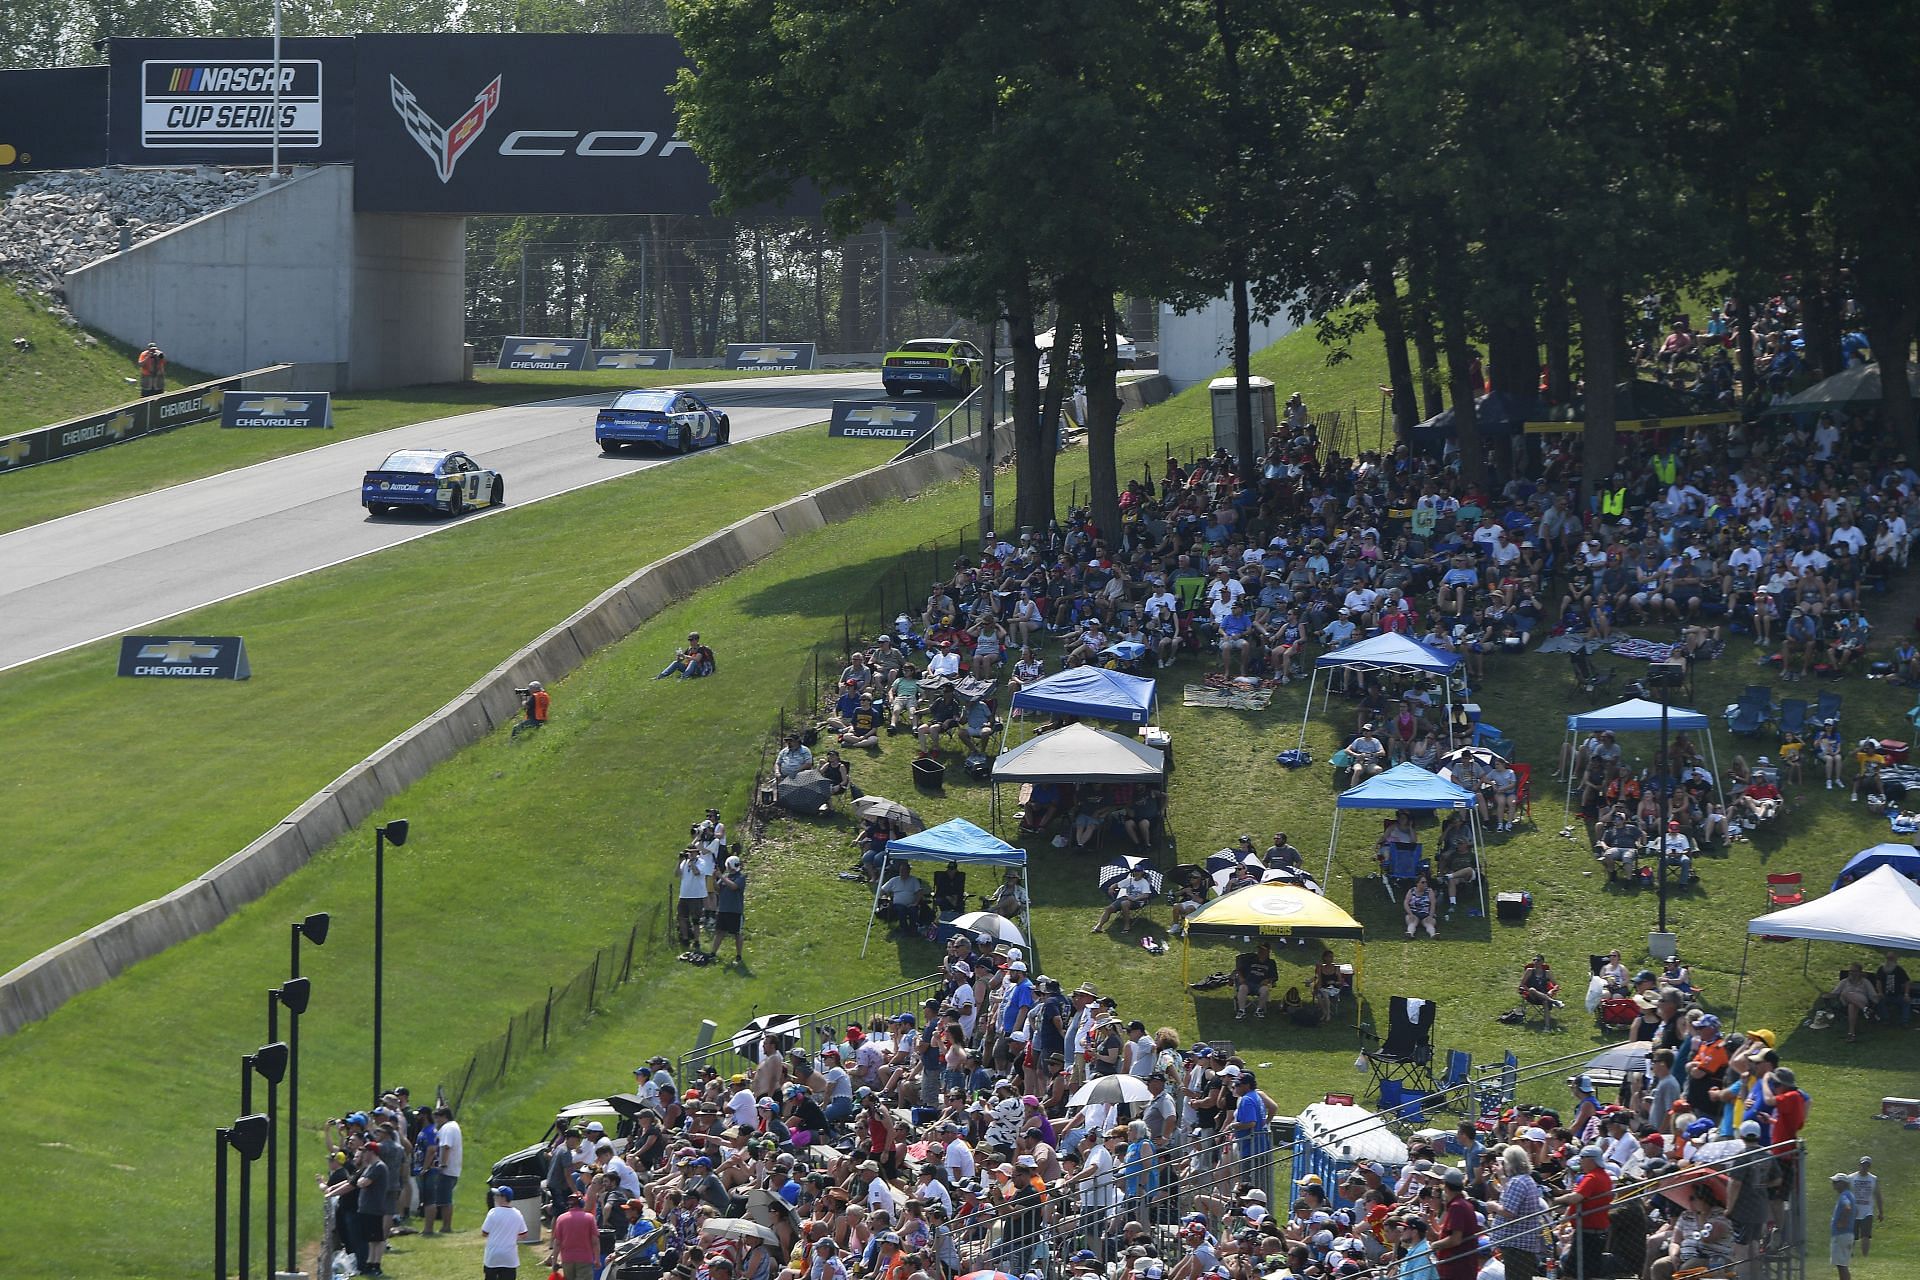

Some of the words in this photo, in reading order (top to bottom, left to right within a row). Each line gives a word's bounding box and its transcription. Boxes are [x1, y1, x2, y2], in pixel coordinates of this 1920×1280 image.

[199, 67, 296, 92] NASCAR
[166, 105, 214, 128] CUP
[215, 105, 297, 128] SERIES
[510, 361, 570, 371] CHEVROLET
[160, 397, 202, 419] CHEVROLET
[235, 418, 311, 427] CHEVROLET
[62, 423, 106, 447] CHEVROLET
[843, 428, 917, 437] CHEVROLET
[134, 666, 219, 675] CHEVROLET
